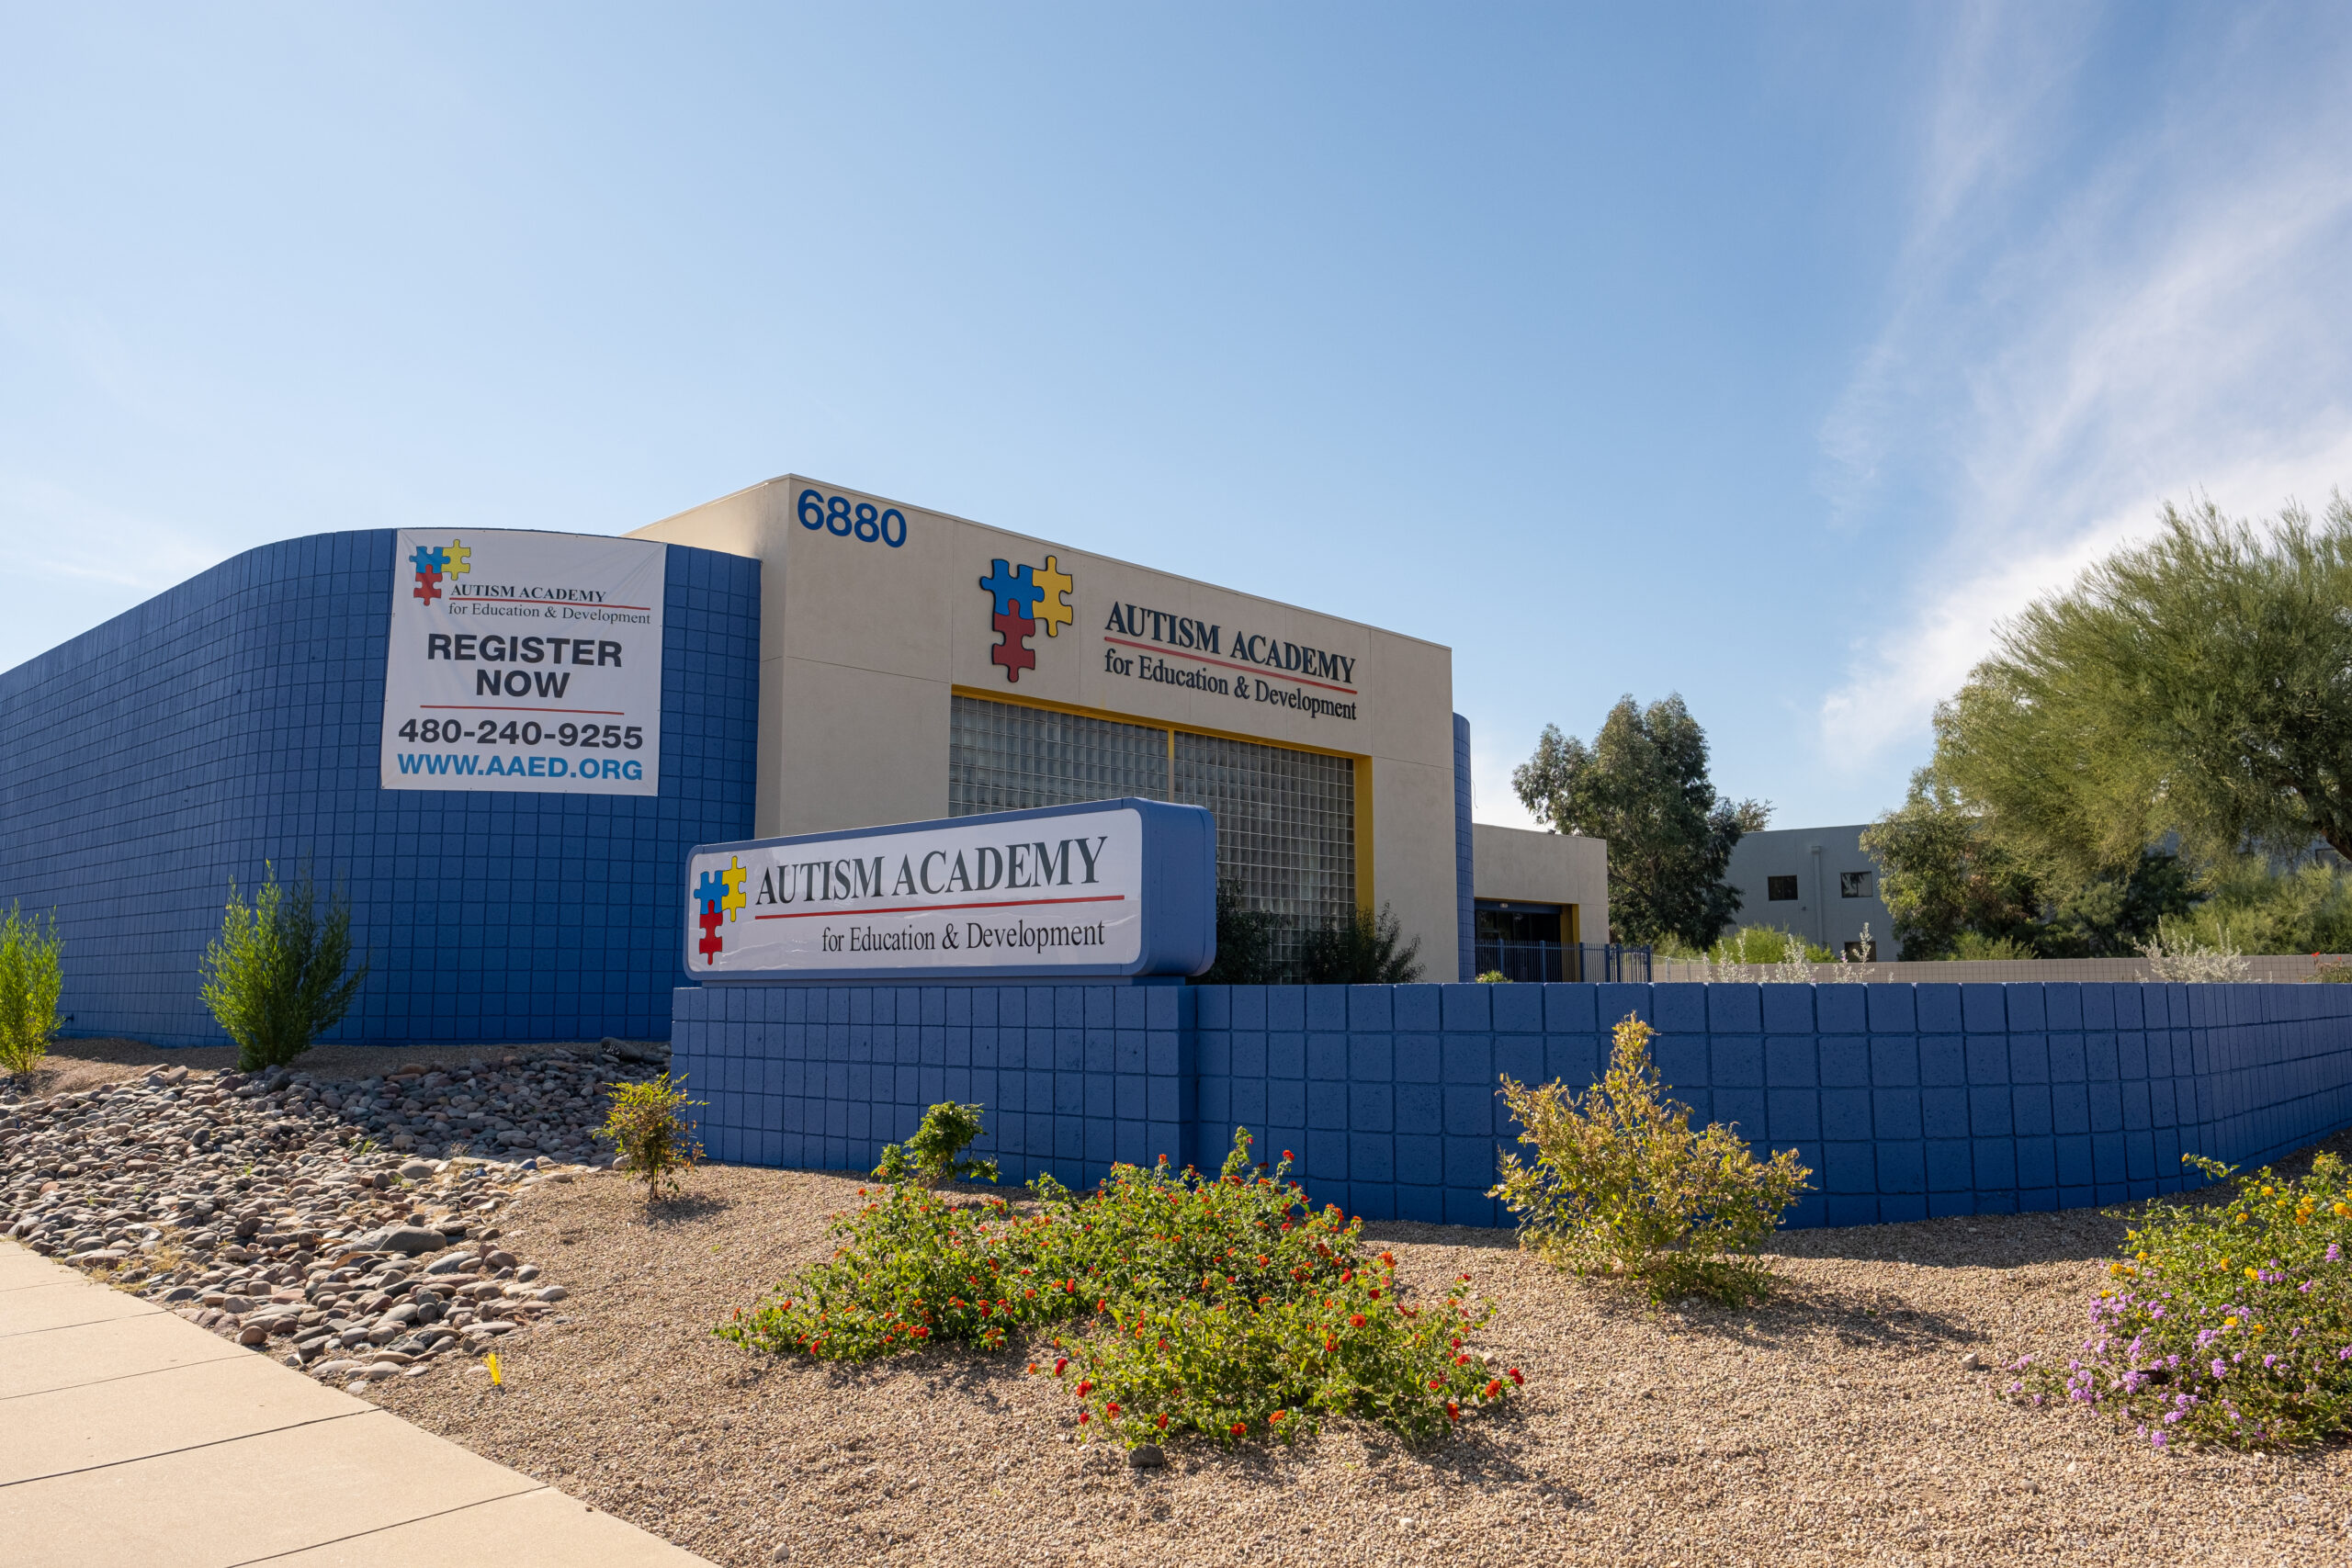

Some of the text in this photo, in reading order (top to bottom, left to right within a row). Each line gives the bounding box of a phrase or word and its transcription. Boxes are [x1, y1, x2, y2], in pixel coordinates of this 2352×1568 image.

[797, 489, 907, 548] 6880
[450, 584, 606, 603] AUTISM ACADEMY
[448, 603, 650, 625] for Education & Development
[427, 633, 623, 668] REGISTER
[1104, 601, 1356, 684] AUTISM ACADEMY
[476, 669, 571, 699] NOW
[1104, 648, 1357, 721] for Education & Development
[398, 718, 643, 750] 480-240-9255
[397, 753, 643, 781] WWW.AAED.ORG
[754, 836, 1108, 906] AUTISM ACADEMY
[822, 919, 1105, 953] for Education & Development
